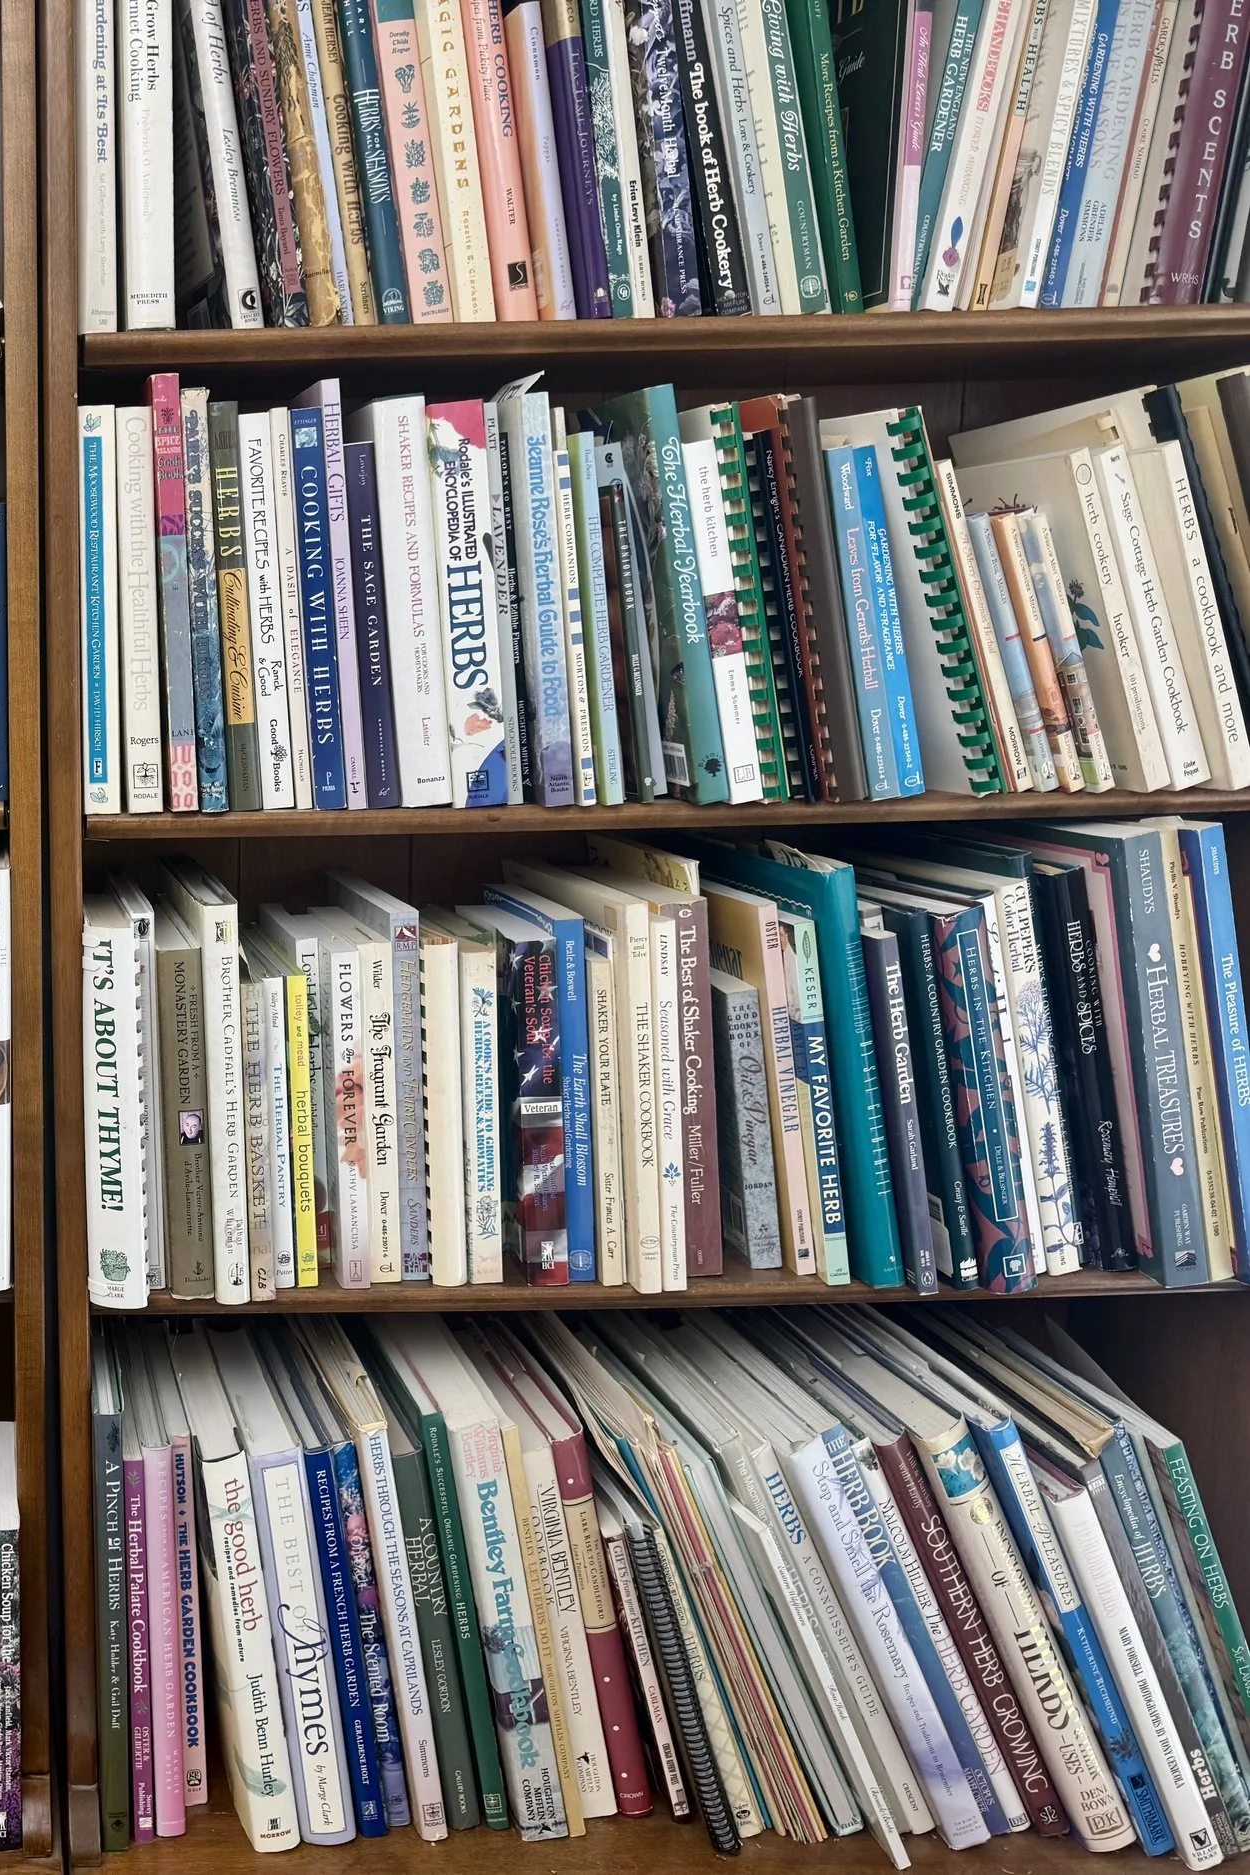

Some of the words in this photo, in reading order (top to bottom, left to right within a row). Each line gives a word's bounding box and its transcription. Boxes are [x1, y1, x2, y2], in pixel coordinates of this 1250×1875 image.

[954, 15, 969, 59] HERB
[965, 31, 976, 54] THE
[689, 62, 704, 98] The
[959, 56, 970, 82] NEW
[353, 89, 380, 135] HERBS
[694, 98, 712, 146] book
[929, 62, 958, 153] GARDENER
[945, 83, 965, 141] ENGLAND
[222, 128, 234, 165] Lesley
[703, 148, 716, 168] of
[364, 150, 391, 204] SEASONS
[704, 170, 721, 212] Herb
[506, 187, 516, 226] WALTER
[711, 216, 733, 291] Cookery
[1171, 272, 1200, 285] WRHS
[660, 436, 681, 480] The
[215, 466, 243, 558] HERBS
[945, 472, 962, 520] SIMMONS
[1175, 478, 1198, 542] HERBS
[300, 465, 324, 580] COOKING
[361, 514, 373, 553] THE
[665, 484, 693, 556] Herbal
[362, 560, 377, 607] SAGE
[1192, 558, 1202, 568] a
[309, 590, 330, 652] WITH
[673, 556, 706, 646] Yearbook
[1195, 575, 1223, 658] cookbook
[448, 561, 490, 691] HERBS
[1112, 613, 1131, 659] hooker
[366, 614, 383, 688] GARDEN
[1214, 662, 1232, 695] and
[313, 665, 335, 745] HERBS
[1222, 702, 1240, 744] more
[130, 736, 159, 747] Rogers
[1007, 726, 1024, 766] MORROW
[1138, 849, 1156, 914] SHAUDYS
[679, 925, 692, 956] The
[92, 938, 114, 992] IT'S
[680, 958, 694, 988] Best
[885, 962, 901, 996] The
[681, 989, 694, 1004] of
[803, 968, 818, 1010] KESER
[681, 1005, 696, 1054] Shaker
[888, 998, 907, 1041] Herb
[92, 999, 119, 1099] ABOUT
[807, 1035, 824, 1066] MY
[684, 1057, 699, 1115] Cooking
[893, 1043, 913, 1105] Garden
[295, 1090, 309, 1137] herbal
[523, 1103, 559, 1114] Veteran
[812, 1073, 837, 1169] FAVORITE
[97, 1105, 124, 1214] THYME!
[297, 1142, 311, 1213] bouquets
[822, 1173, 842, 1225] HERB
[224, 1478, 241, 1514] the
[763, 1470, 807, 1546] HERBS
[418, 1517, 433, 1532] A
[1169, 1459, 1203, 1529] FEASTING
[1195, 1532, 1212, 1558] ON
[1205, 1560, 1230, 1609] HERBS
[224, 1522, 249, 1575] good
[405, 1536, 433, 1607] HERBAL
[420, 1537, 447, 1617] COUNTRY
[237, 1579, 260, 1632] herb
[921, 1515, 980, 1631] SOUTHERN
[969, 1632, 1004, 1687] HERB
[991, 1696, 1050, 1795] GROWING
[246, 1673, 264, 1717] Judith
[252, 1718, 268, 1751] Benn
[257, 1754, 276, 1798] Hurley
[260, 1831, 291, 1840] MORROW
